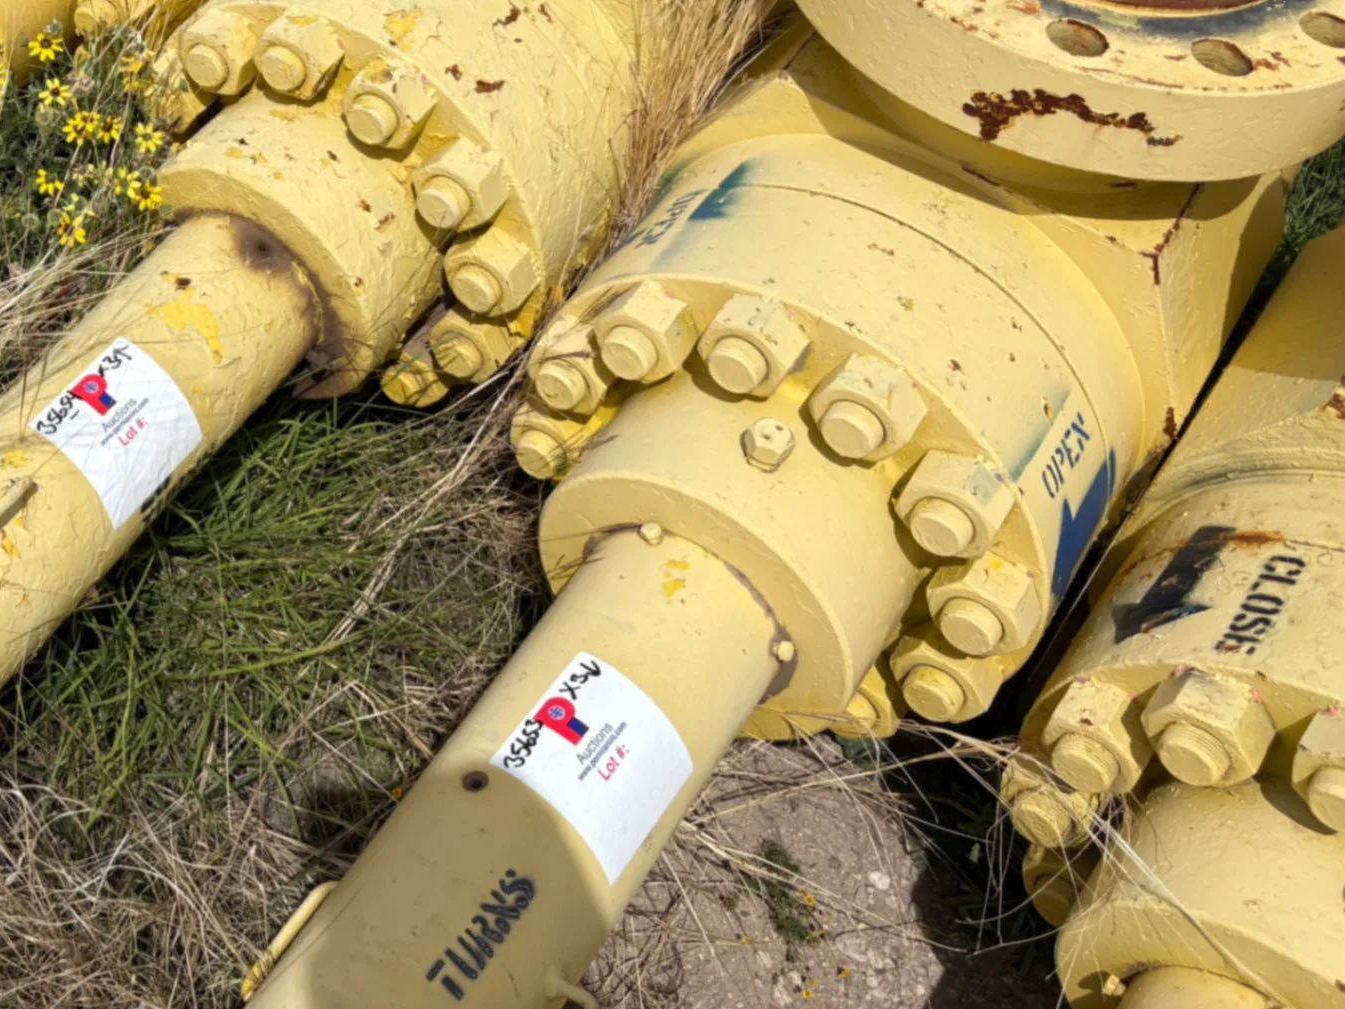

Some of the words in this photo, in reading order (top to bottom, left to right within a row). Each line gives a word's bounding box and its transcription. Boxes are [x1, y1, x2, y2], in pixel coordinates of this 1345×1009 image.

[117, 425, 139, 447] Lot
[1042, 411, 1091, 499] OPEN
[1214, 555, 1306, 655] CLOSE
[502, 718, 544, 769] 35653
[575, 722, 615, 766] Auctions
[596, 754, 621, 782] Lot
[614, 744, 630, 760] #:
[424, 868, 536, 1001] TURNS
